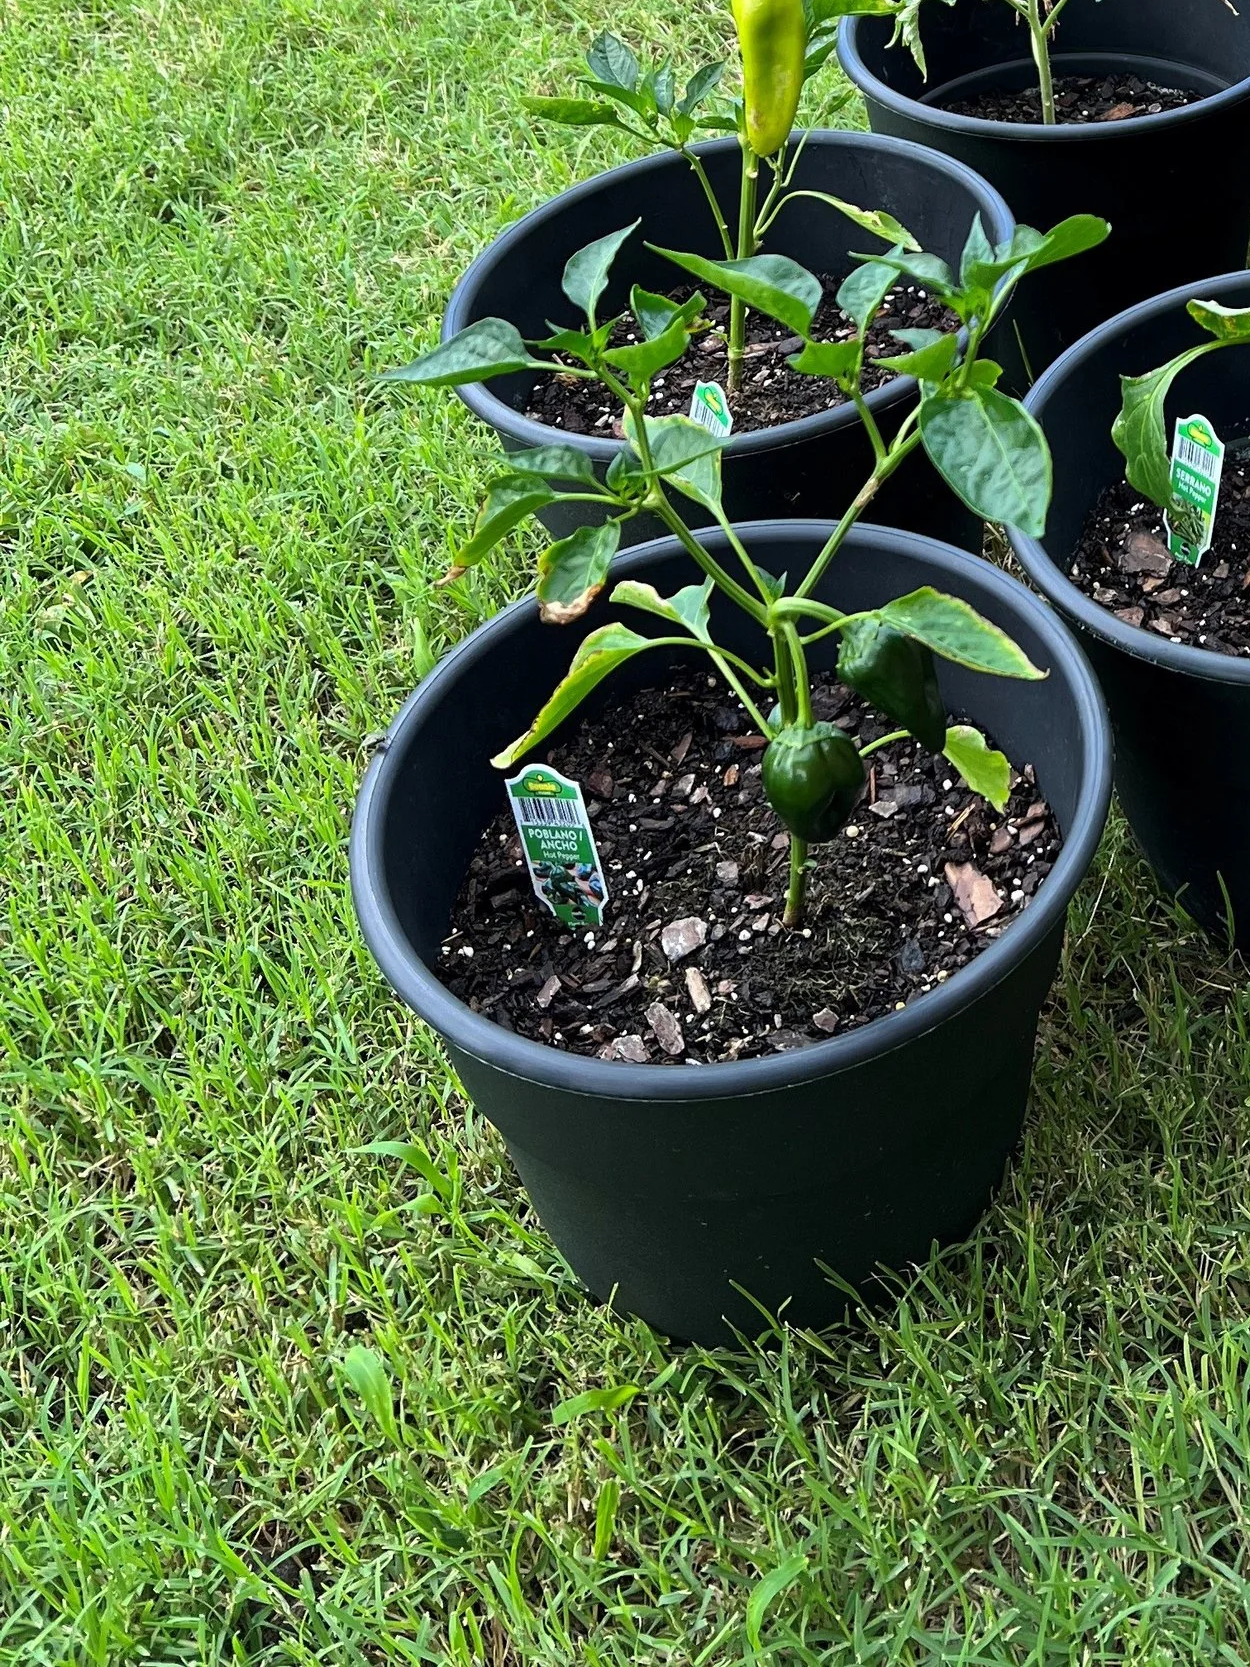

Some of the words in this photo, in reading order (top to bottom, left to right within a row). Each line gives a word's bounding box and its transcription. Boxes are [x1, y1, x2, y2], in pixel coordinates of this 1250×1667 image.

[1176, 468, 1211, 497] SERRANO
[528, 828, 577, 841] POBLANO
[541, 839, 578, 851] ANCHO
[543, 850, 557, 859] Hot
[557, 851, 580, 860] Pepper
